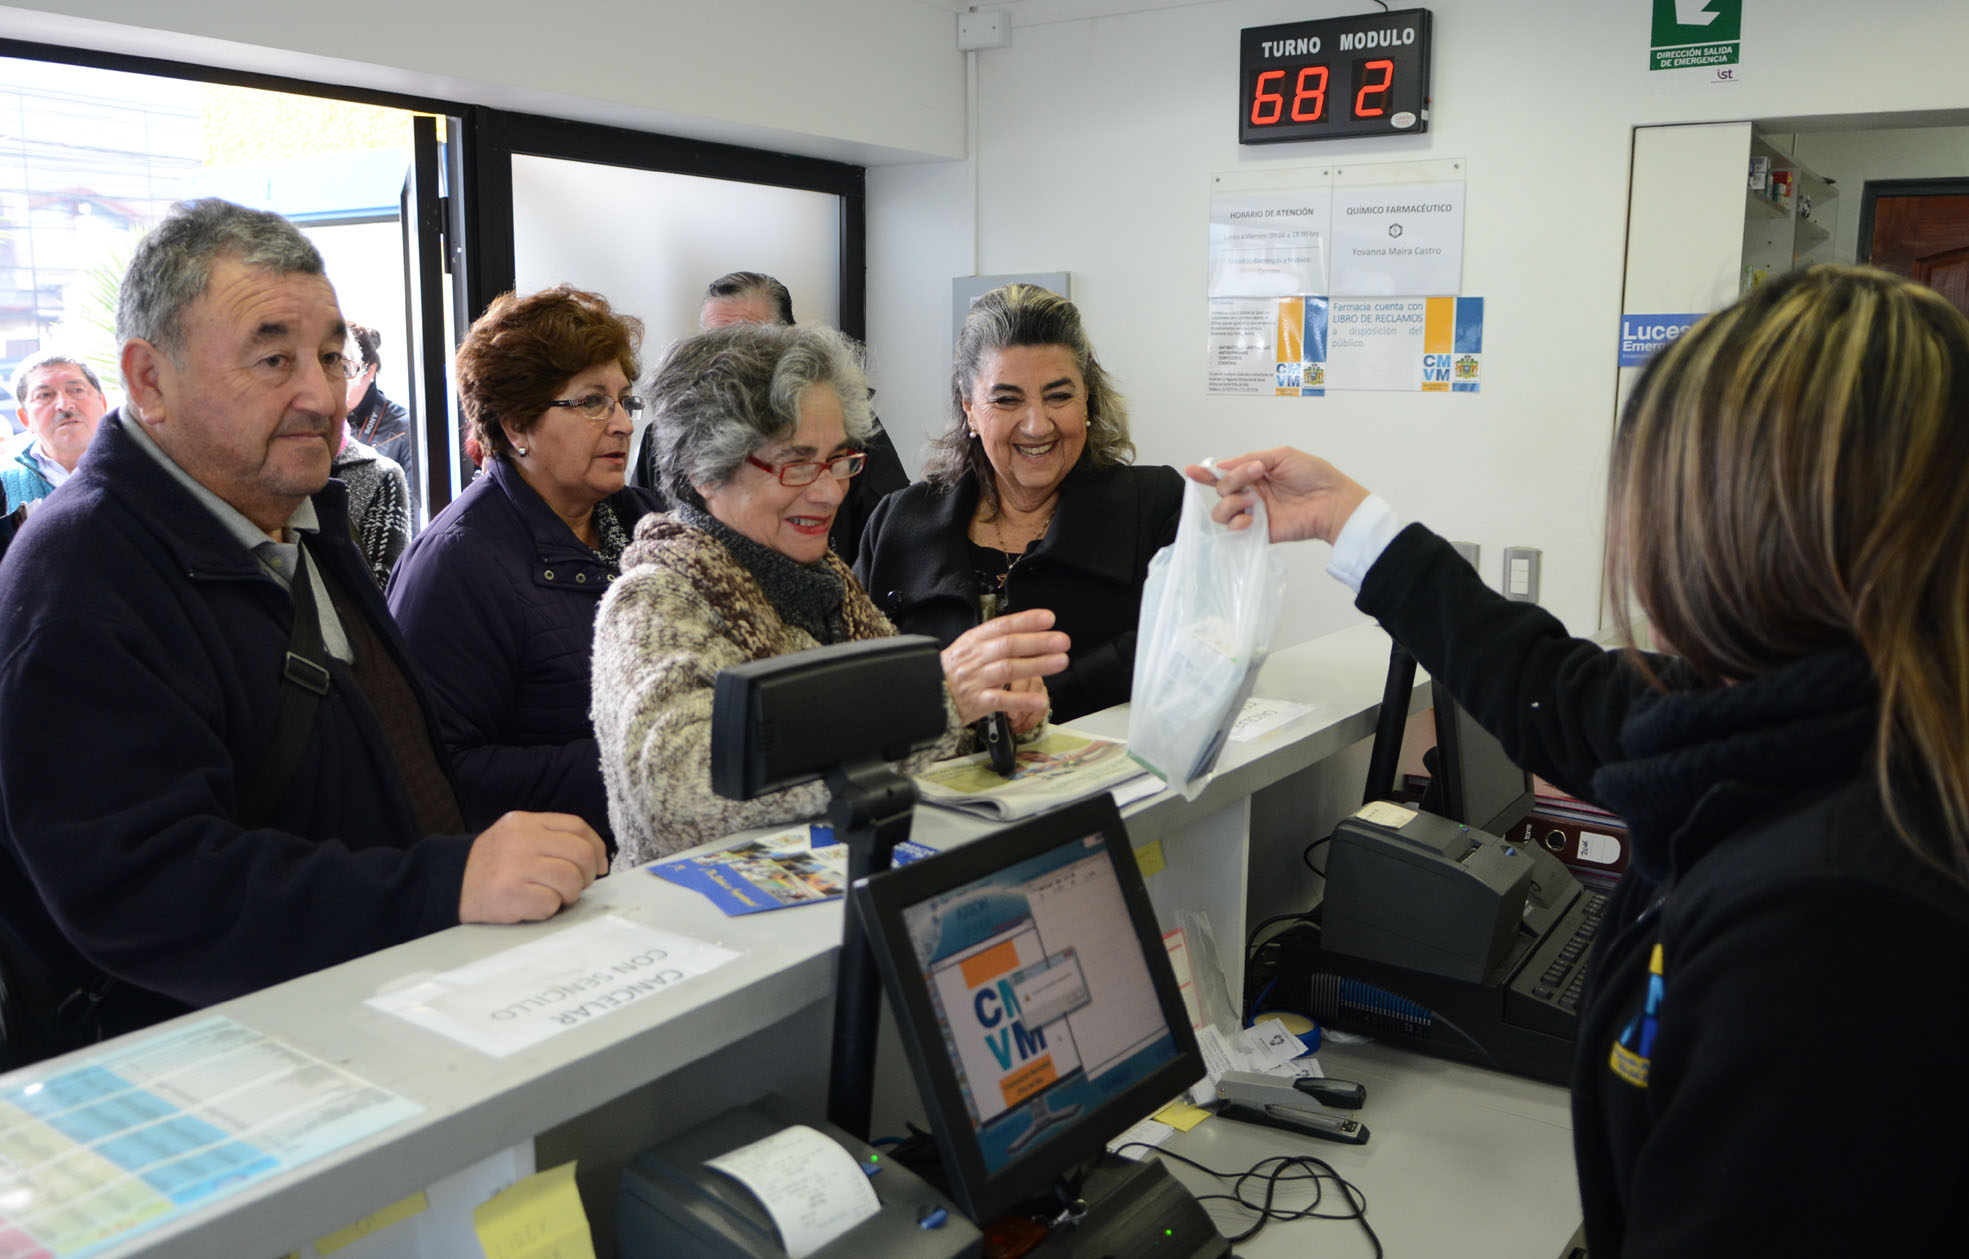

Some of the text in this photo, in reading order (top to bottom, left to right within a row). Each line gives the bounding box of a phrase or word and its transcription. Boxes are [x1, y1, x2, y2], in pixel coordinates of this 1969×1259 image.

[1261, 27, 1415, 58] TURNO MODULO
[1656, 46, 1733, 60] DIRECCIÓN SALIDA
[1660, 55, 1728, 67] DE EMERGENCIA
[1717, 69, 1733, 80] ist
[1251, 59, 1394, 125] 68 2
[1230, 207, 1314, 219] HORARIO DE ATENCIÓN
[1346, 203, 1453, 216] QUÍMICO FARMACÉUTICO
[1352, 247, 1386, 256] Yovanna
[1414, 246, 1442, 255] Castro
[1333, 302, 1423, 312] Farmacia cuenta con
[1333, 313, 1423, 323] LIBRO DE RECLAMOS
[1332, 325, 1423, 337] a disposición del
[1331, 338, 1364, 348] público.
[1423, 354, 1451, 368] CM
[1276, 375, 1300, 387] VM
[1423, 368, 1450, 381] VM
[364, 411, 378, 434] SONY
[490, 949, 668, 1021] CON SENCILLO
[549, 969, 684, 1025] CANCELAR
[984, 1019, 1048, 1071] VM
